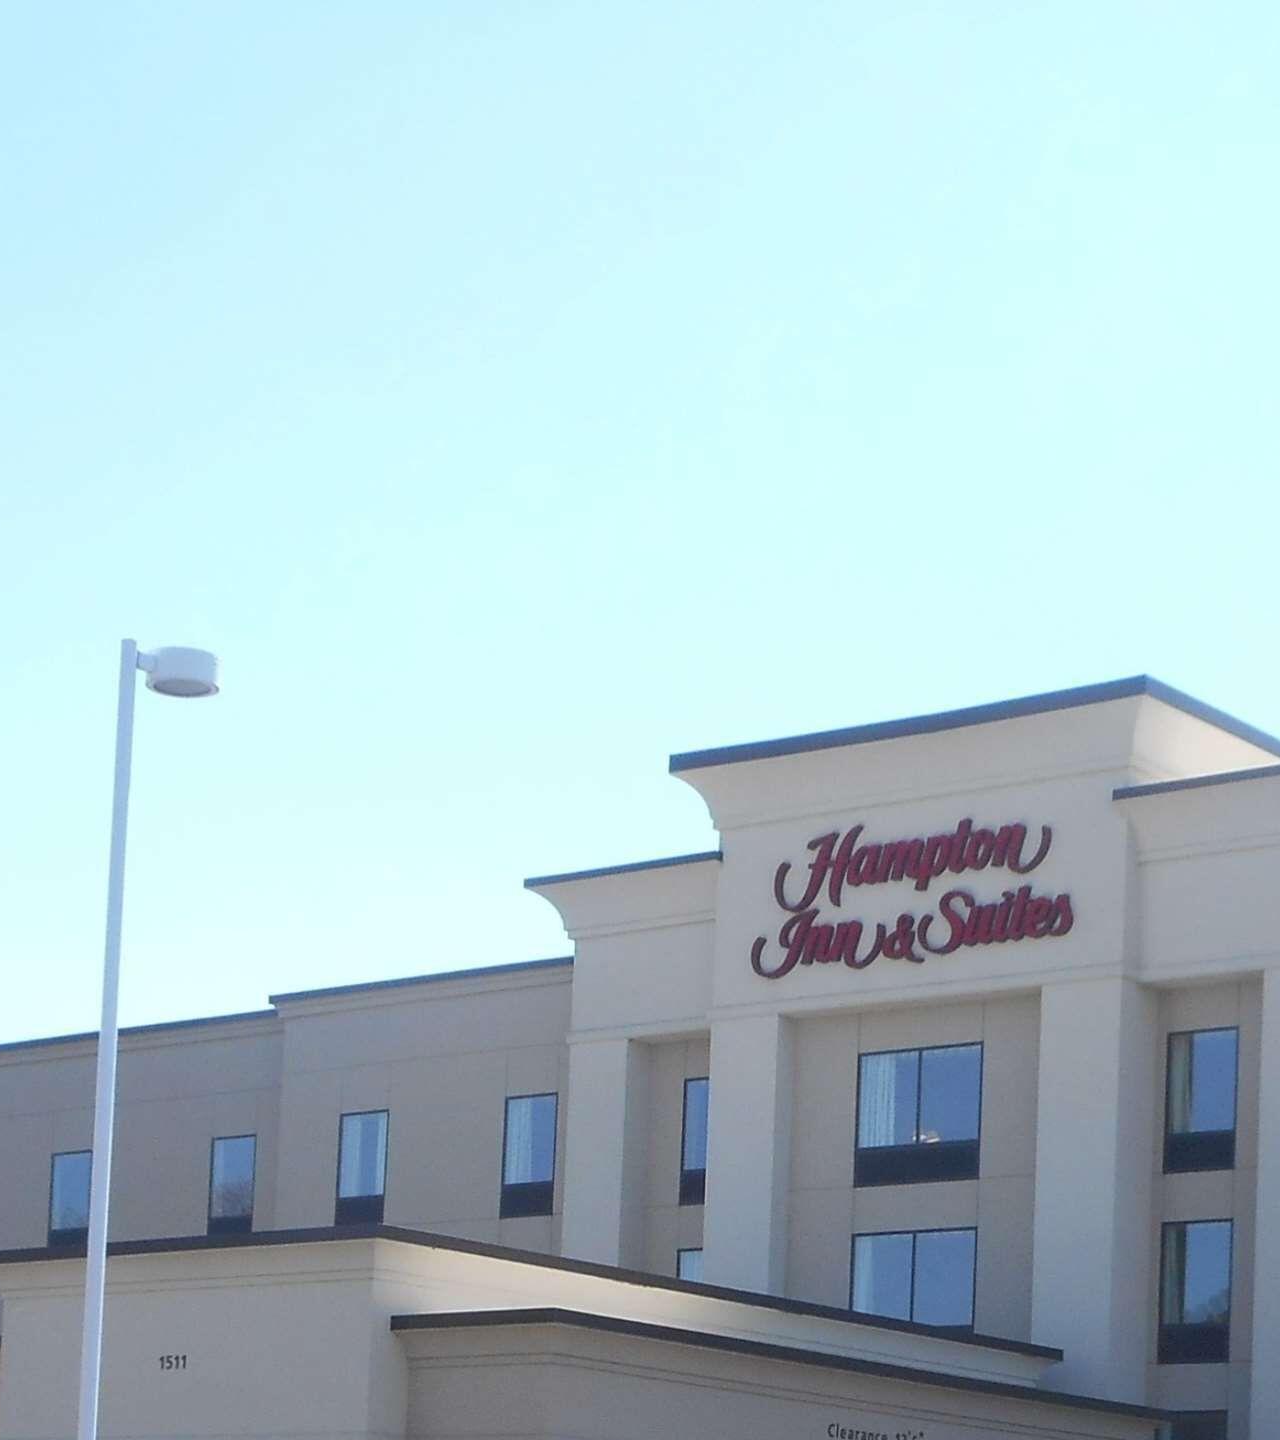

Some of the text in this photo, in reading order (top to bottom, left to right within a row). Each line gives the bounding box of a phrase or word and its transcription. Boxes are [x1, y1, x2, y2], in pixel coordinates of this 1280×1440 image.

[774, 818, 1052, 912] Hampton
[751, 885, 1073, 979] Inn & Suites
[159, 1355, 187, 1370] 1511
